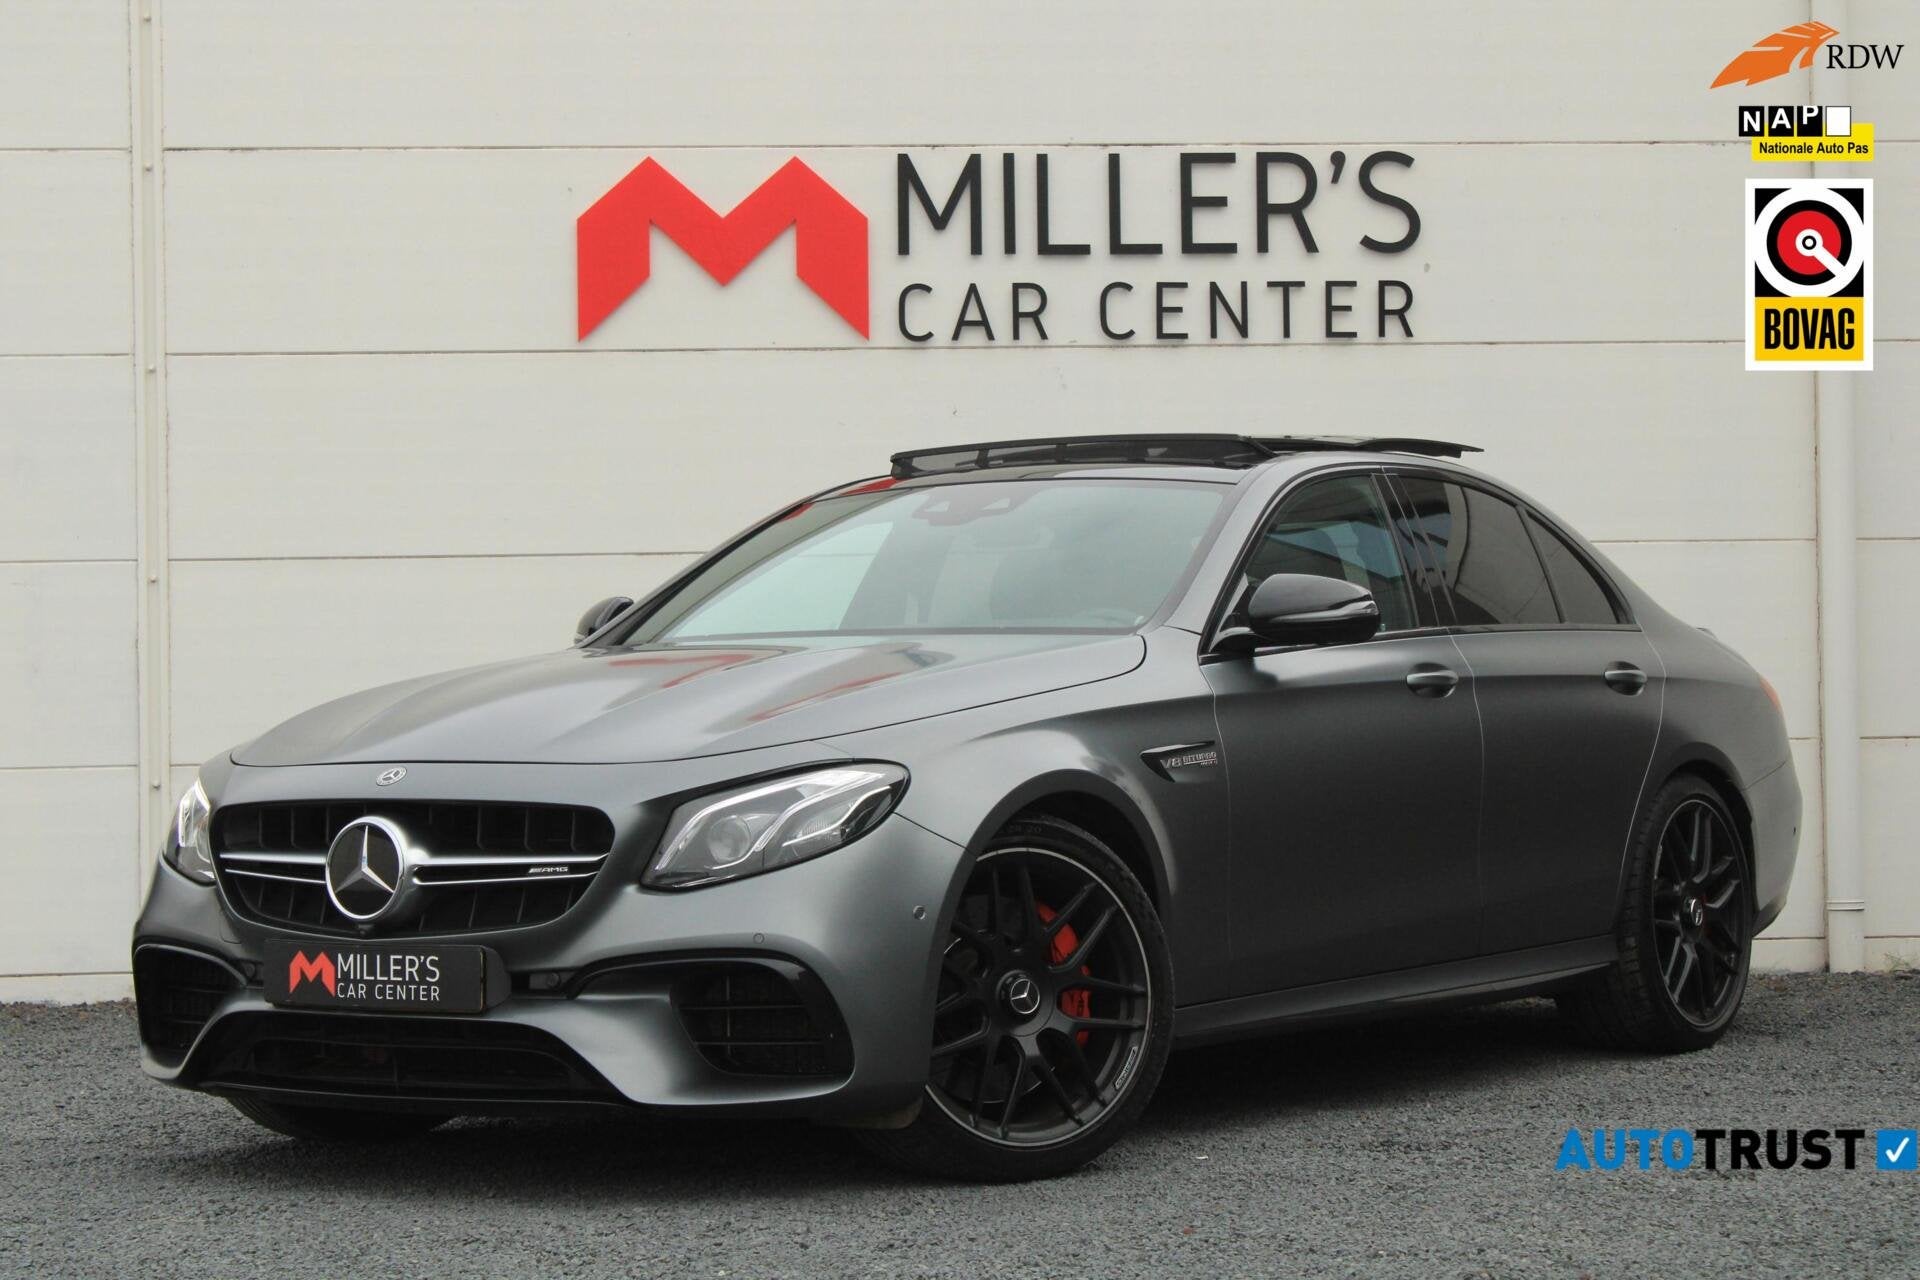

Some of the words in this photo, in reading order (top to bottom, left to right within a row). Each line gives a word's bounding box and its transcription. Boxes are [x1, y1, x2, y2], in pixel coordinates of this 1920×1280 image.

[898, 150, 1421, 256] MILLER'S
[898, 283, 1050, 343] CAR
[1099, 280, 1416, 341] CENTER
[337, 952, 440, 982] MILLER'S
[337, 983, 366, 999] CAR
[375, 984, 440, 1001] CENTER
